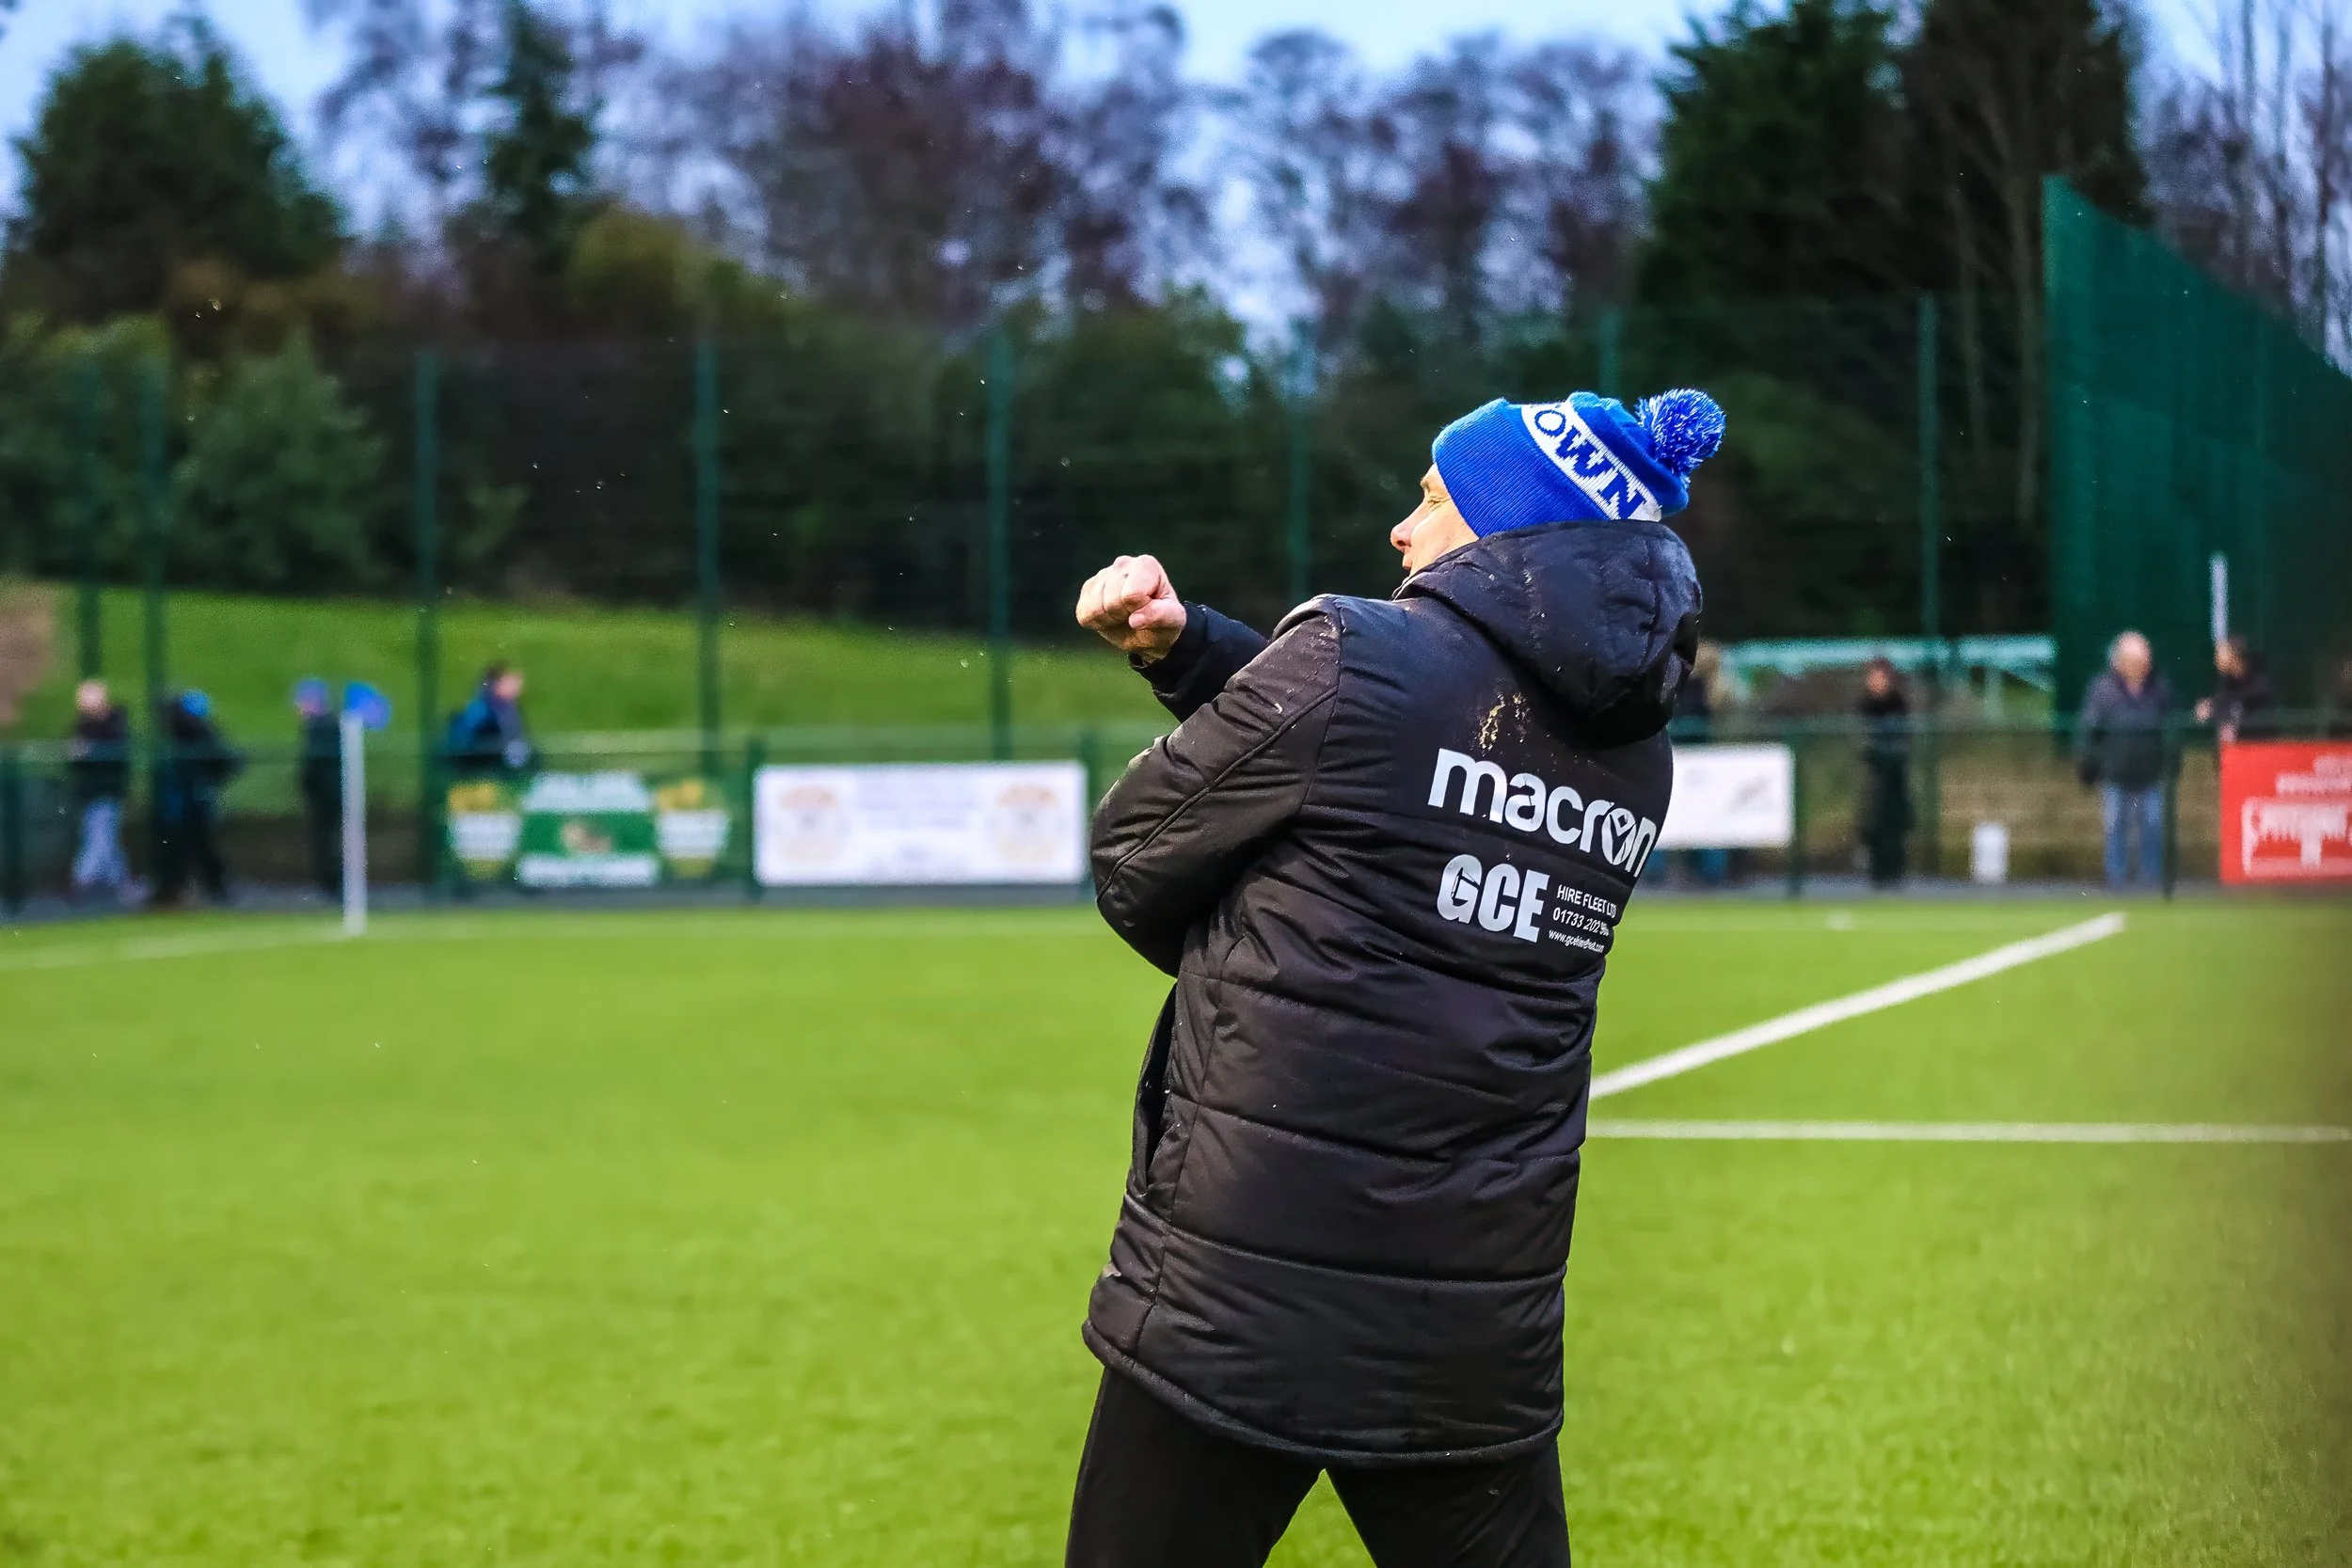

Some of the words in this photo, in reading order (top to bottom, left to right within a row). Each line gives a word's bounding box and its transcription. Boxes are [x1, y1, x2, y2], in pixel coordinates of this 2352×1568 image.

[1427, 748, 1657, 878] macron
[1437, 854, 1550, 942] GCE
[1552, 907, 1585, 928] 01733
[1556, 884, 1583, 905] HIRE
[1582, 893, 1608, 913] FLEET
